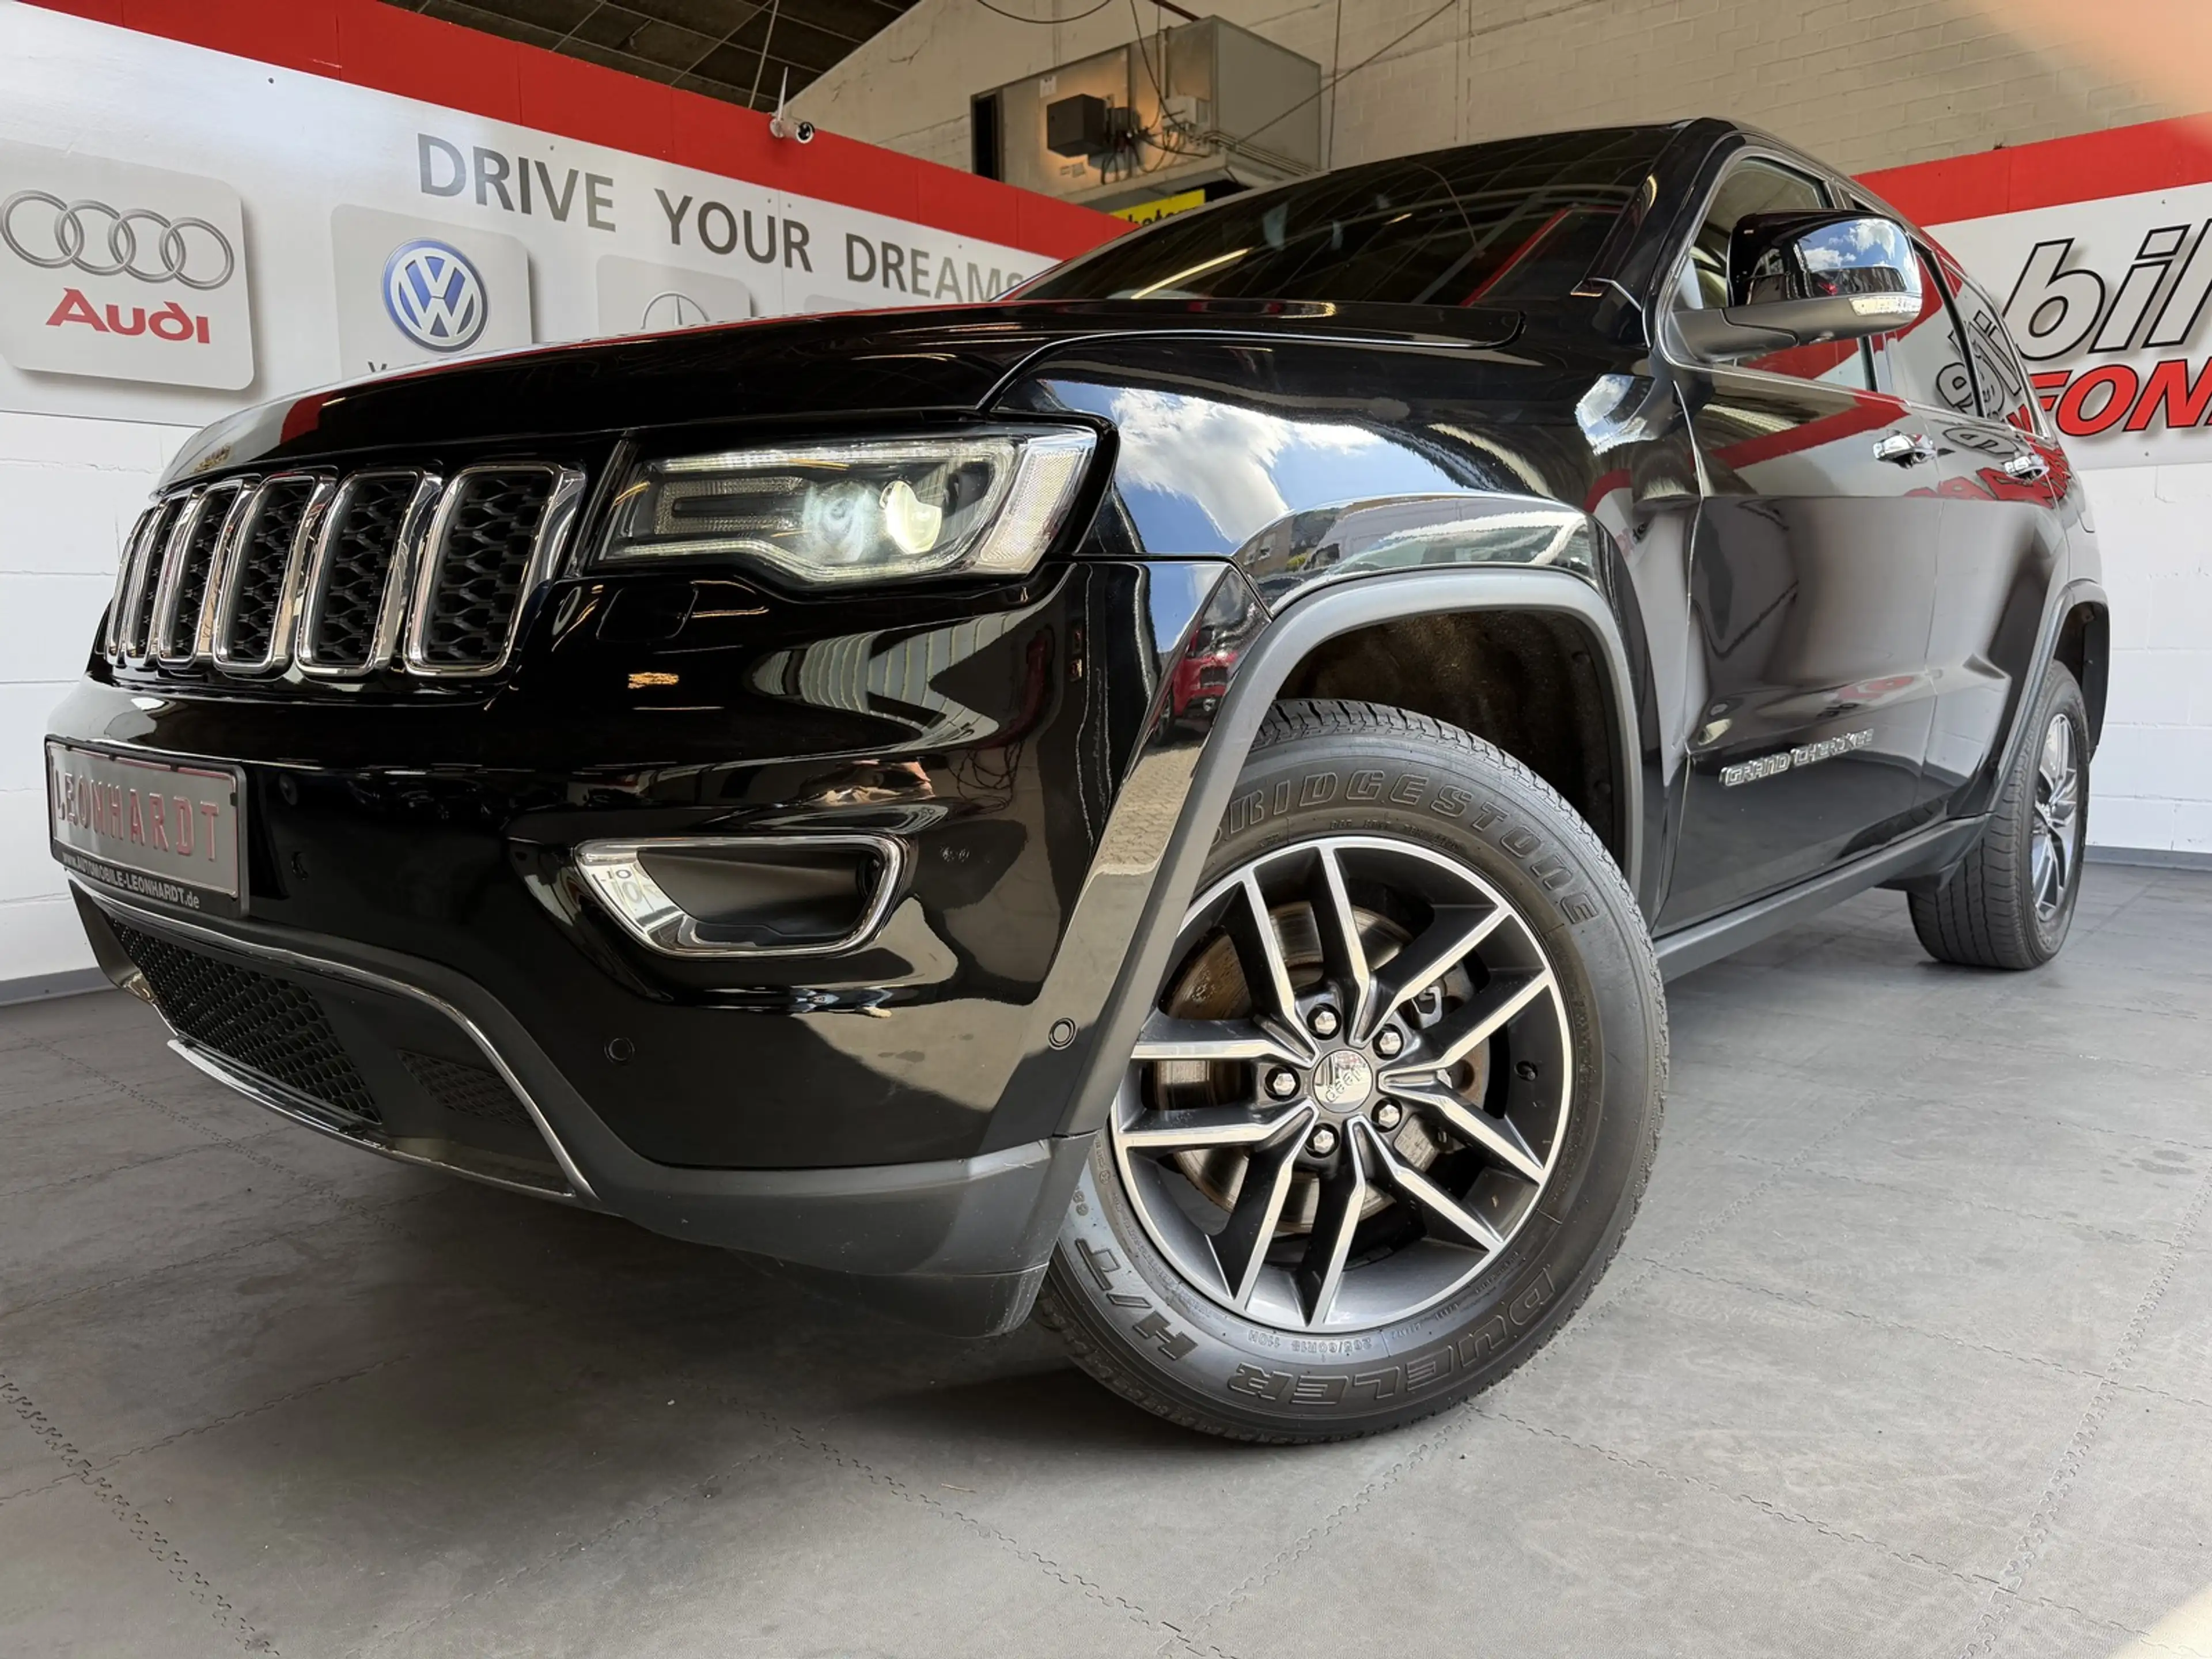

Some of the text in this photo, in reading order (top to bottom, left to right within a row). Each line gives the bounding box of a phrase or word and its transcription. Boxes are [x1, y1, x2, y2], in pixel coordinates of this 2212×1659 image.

[417, 133, 616, 232] DRIVE
[654, 188, 814, 274] YOUR
[46, 287, 211, 344] Audi
[54, 769, 219, 862] LEONHARDT
[1720, 751, 1790, 787] GRAND
[1228, 1267, 1556, 1406] DUELER
